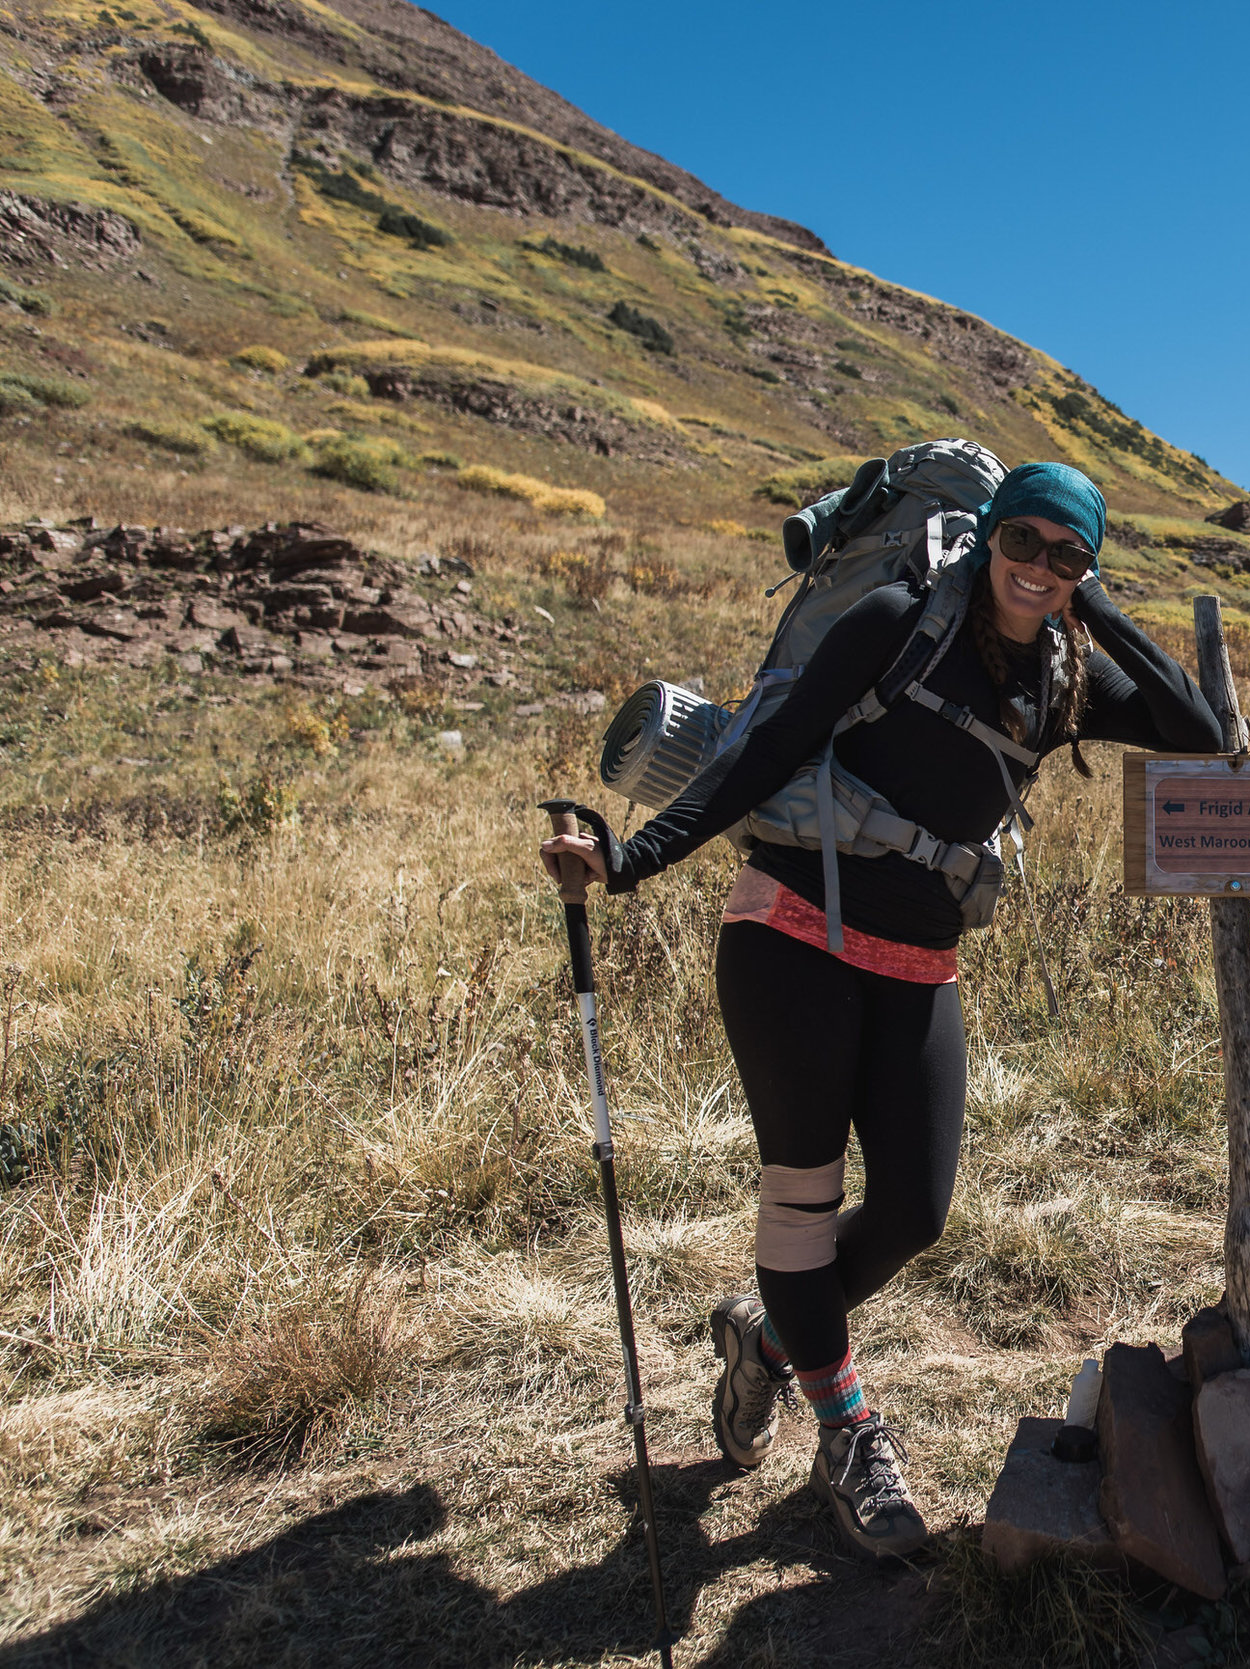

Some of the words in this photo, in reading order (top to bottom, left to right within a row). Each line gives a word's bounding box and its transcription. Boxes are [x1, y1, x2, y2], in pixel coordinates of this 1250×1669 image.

[1200, 801, 1243, 818] Frigid
[1159, 835, 1196, 848] West
[590, 1029, 599, 1055] Black
[593, 1056, 605, 1097] Diamond
